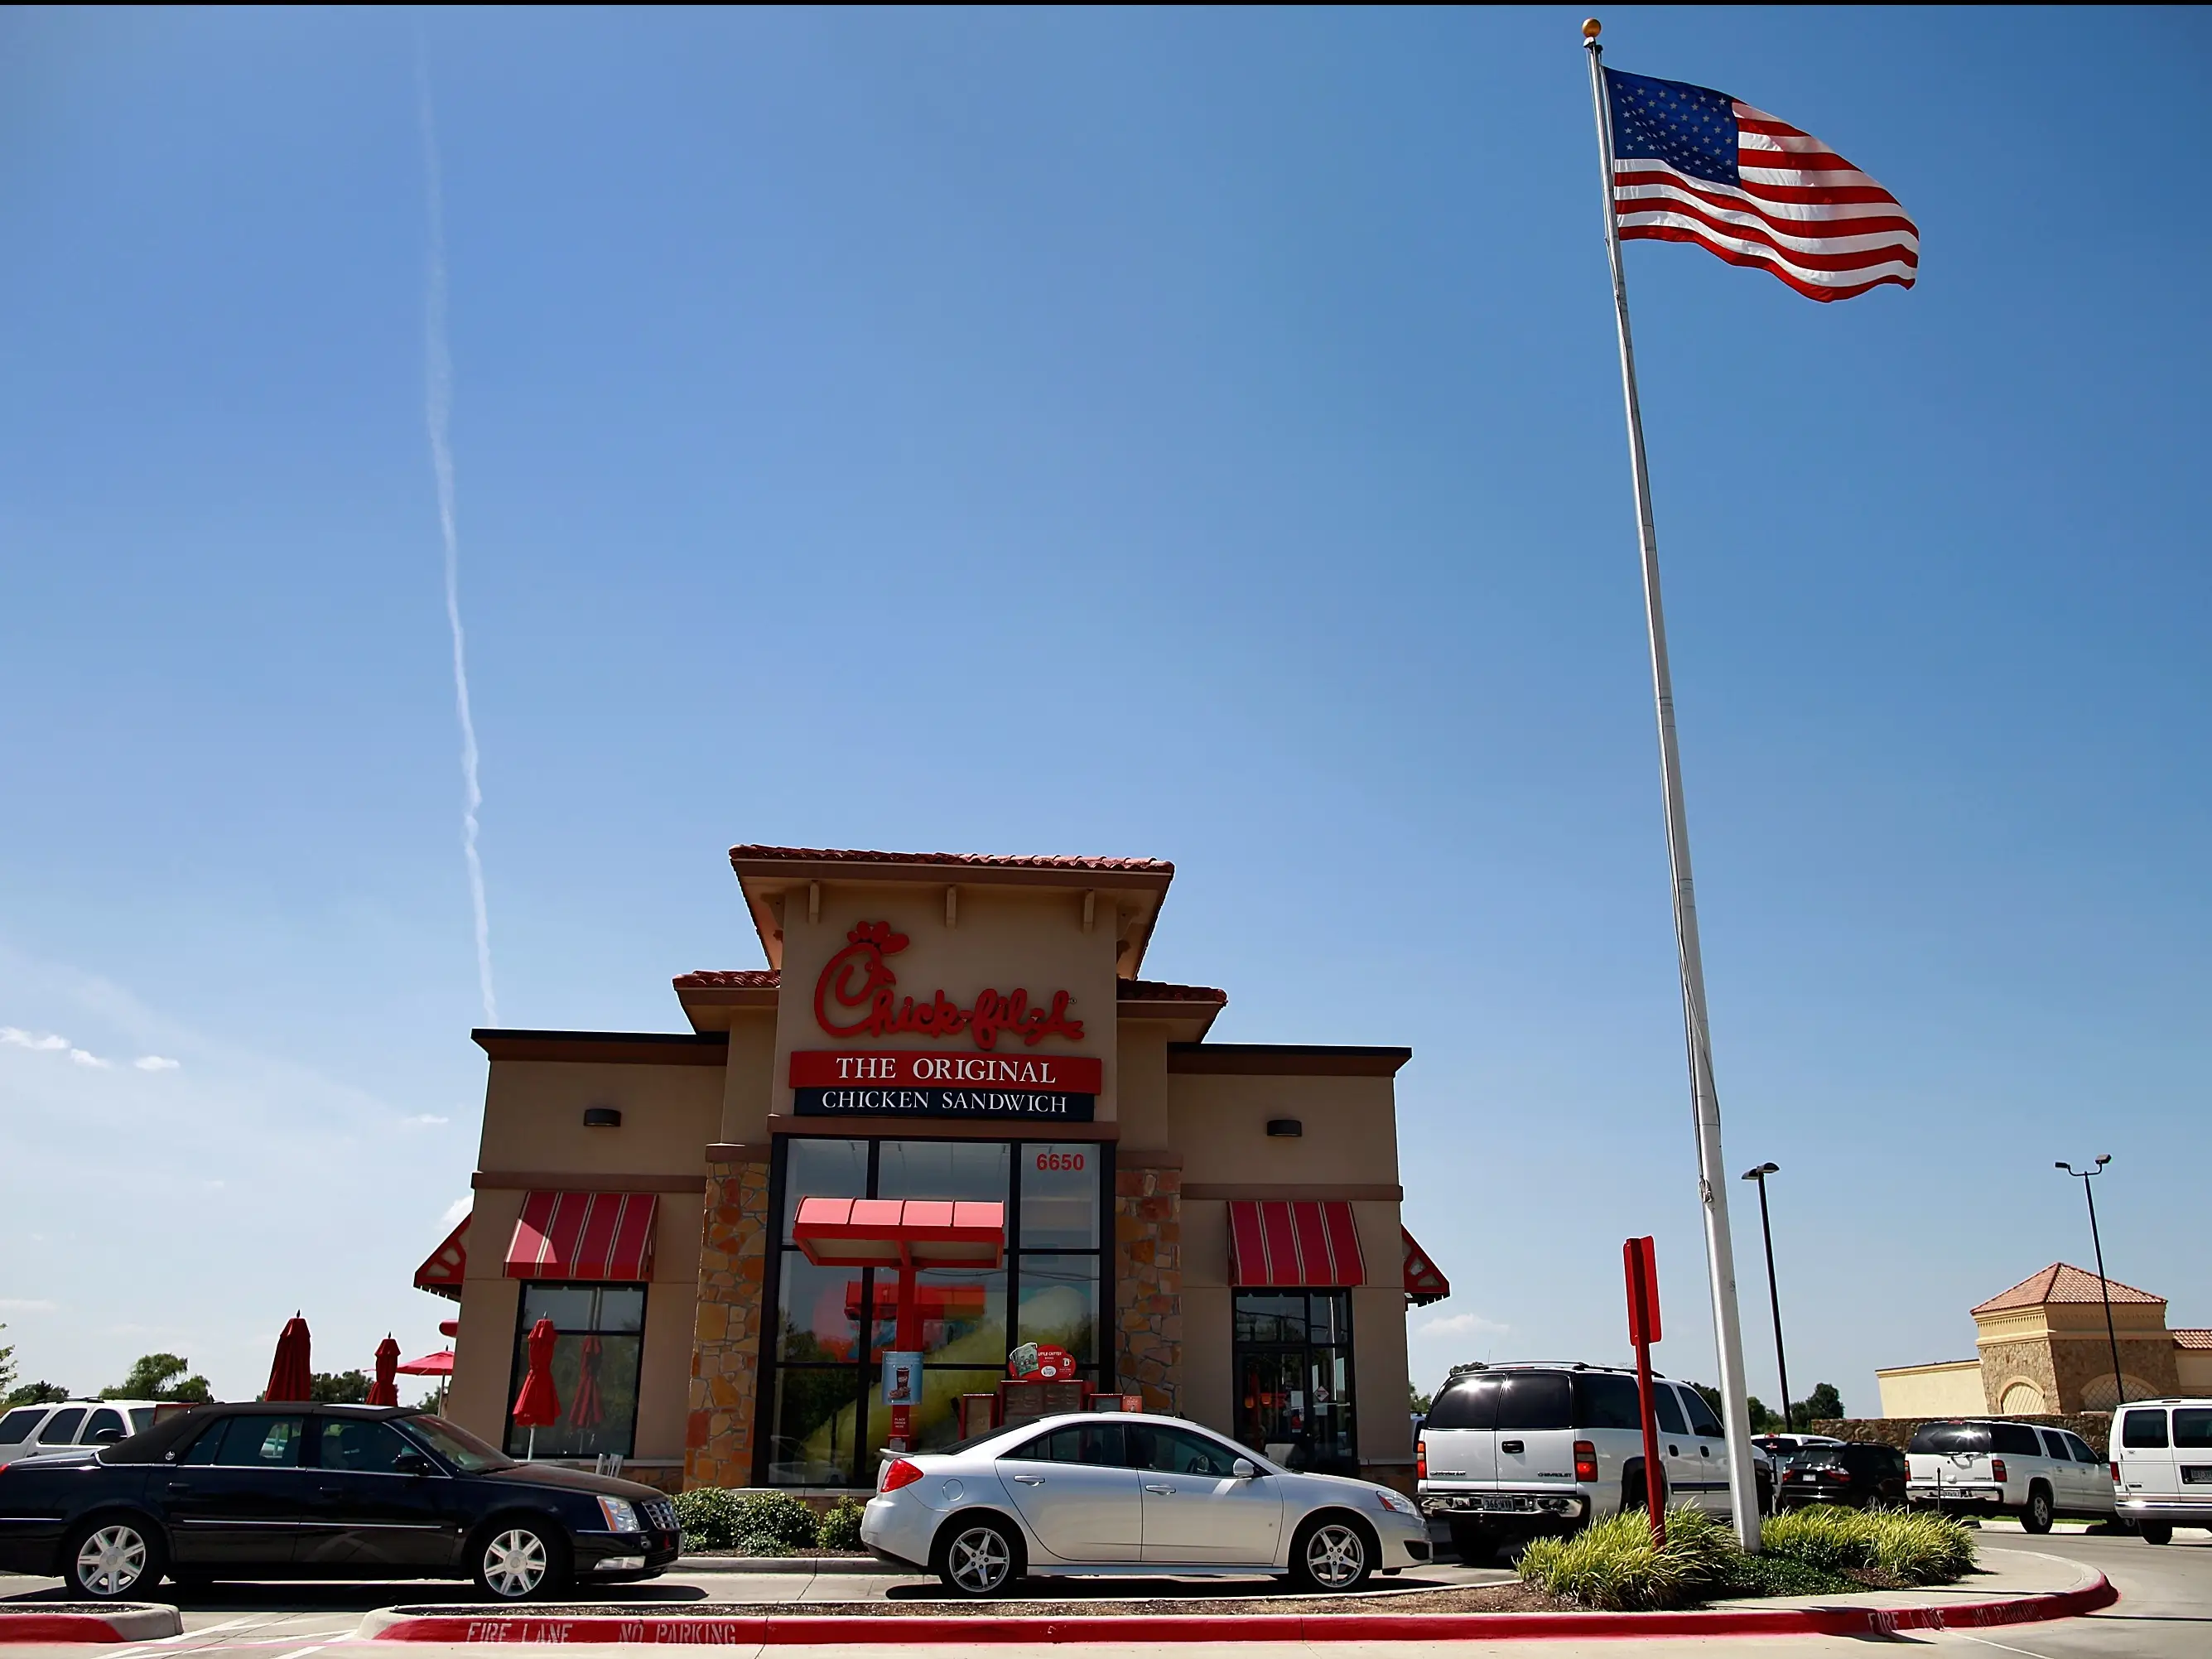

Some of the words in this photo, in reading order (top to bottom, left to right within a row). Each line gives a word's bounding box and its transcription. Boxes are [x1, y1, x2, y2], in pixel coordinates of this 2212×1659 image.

[814, 922, 1085, 1050] Chick-fil-A
[836, 1057, 897, 1078] THE
[913, 1059, 1056, 1084] ORIGINAL
[822, 1090, 929, 1109] CHICKEN
[942, 1092, 1067, 1113] SANDWICH
[1036, 1153, 1085, 1172] 6650
[1867, 1611, 1899, 1632] FIRE
[466, 1622, 512, 1643] FIRE
[521, 1623, 573, 1643] LANE
[619, 1623, 644, 1643] NO
[656, 1623, 736, 1645] PARKING
